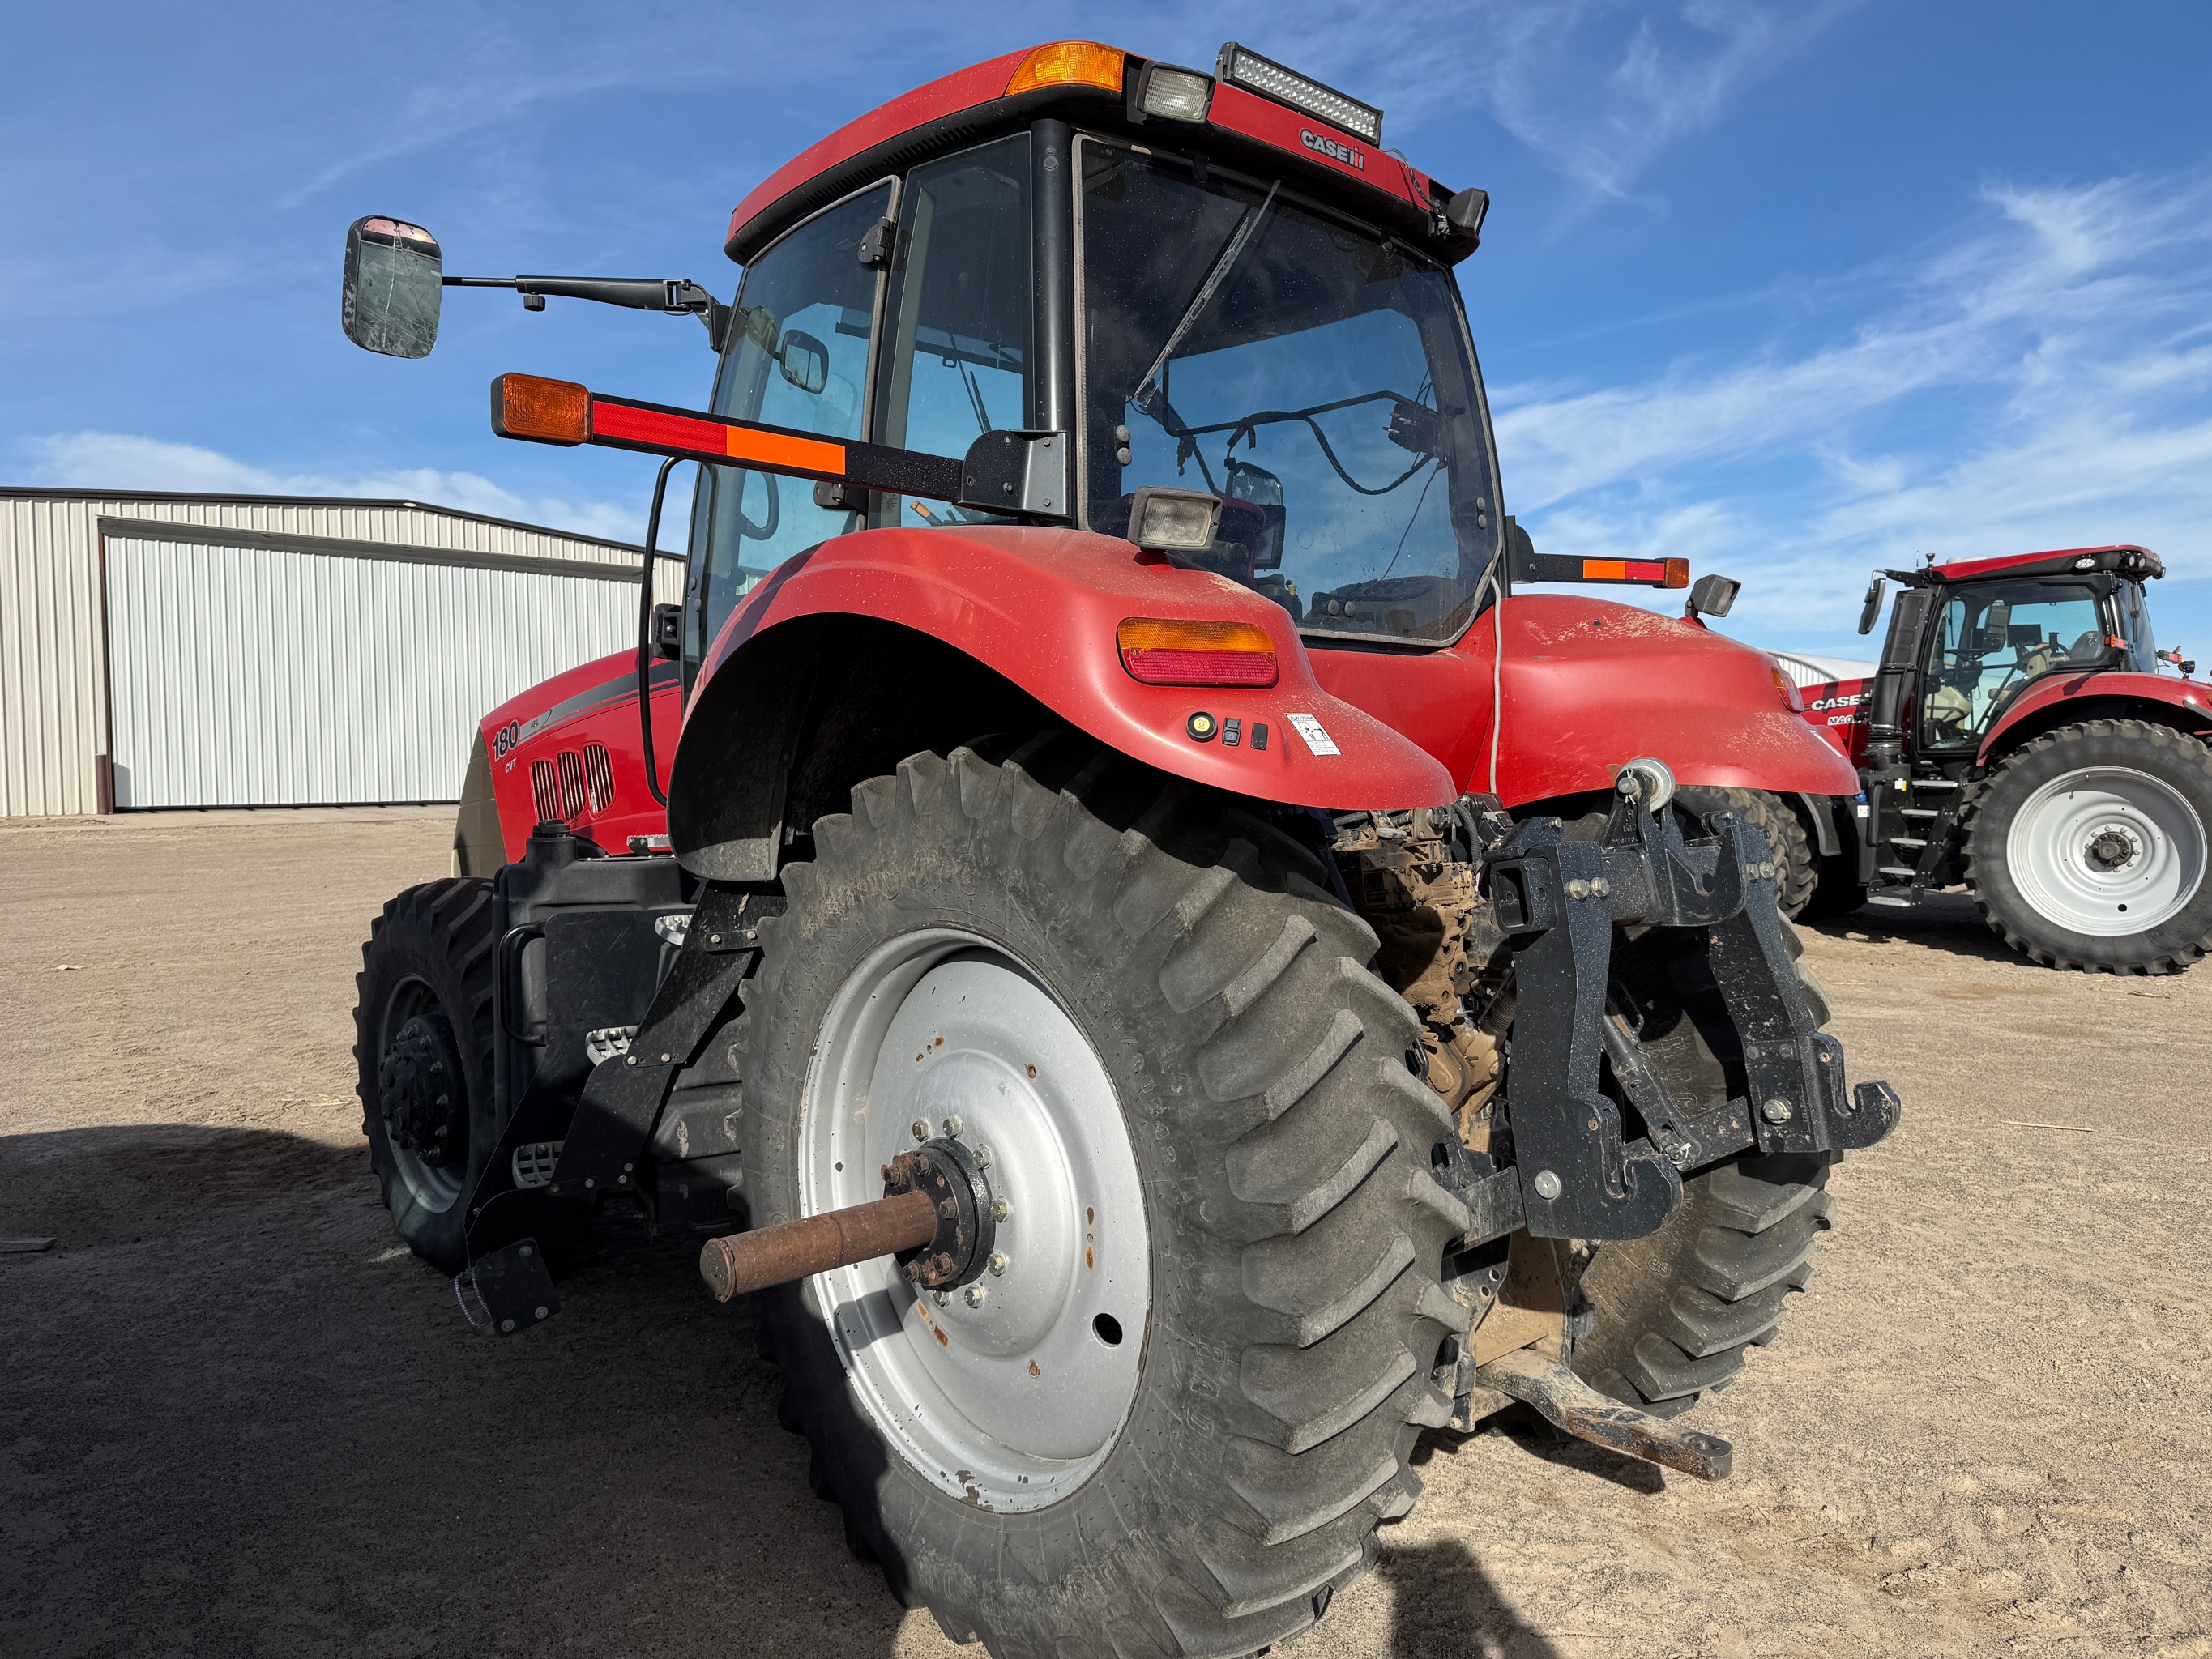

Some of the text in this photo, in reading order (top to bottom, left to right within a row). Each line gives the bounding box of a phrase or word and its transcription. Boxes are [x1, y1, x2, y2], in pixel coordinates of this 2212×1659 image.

[1811, 693, 1861, 710] CASE
[492, 719, 519, 762] 180
[505, 757, 517, 774] CVT
